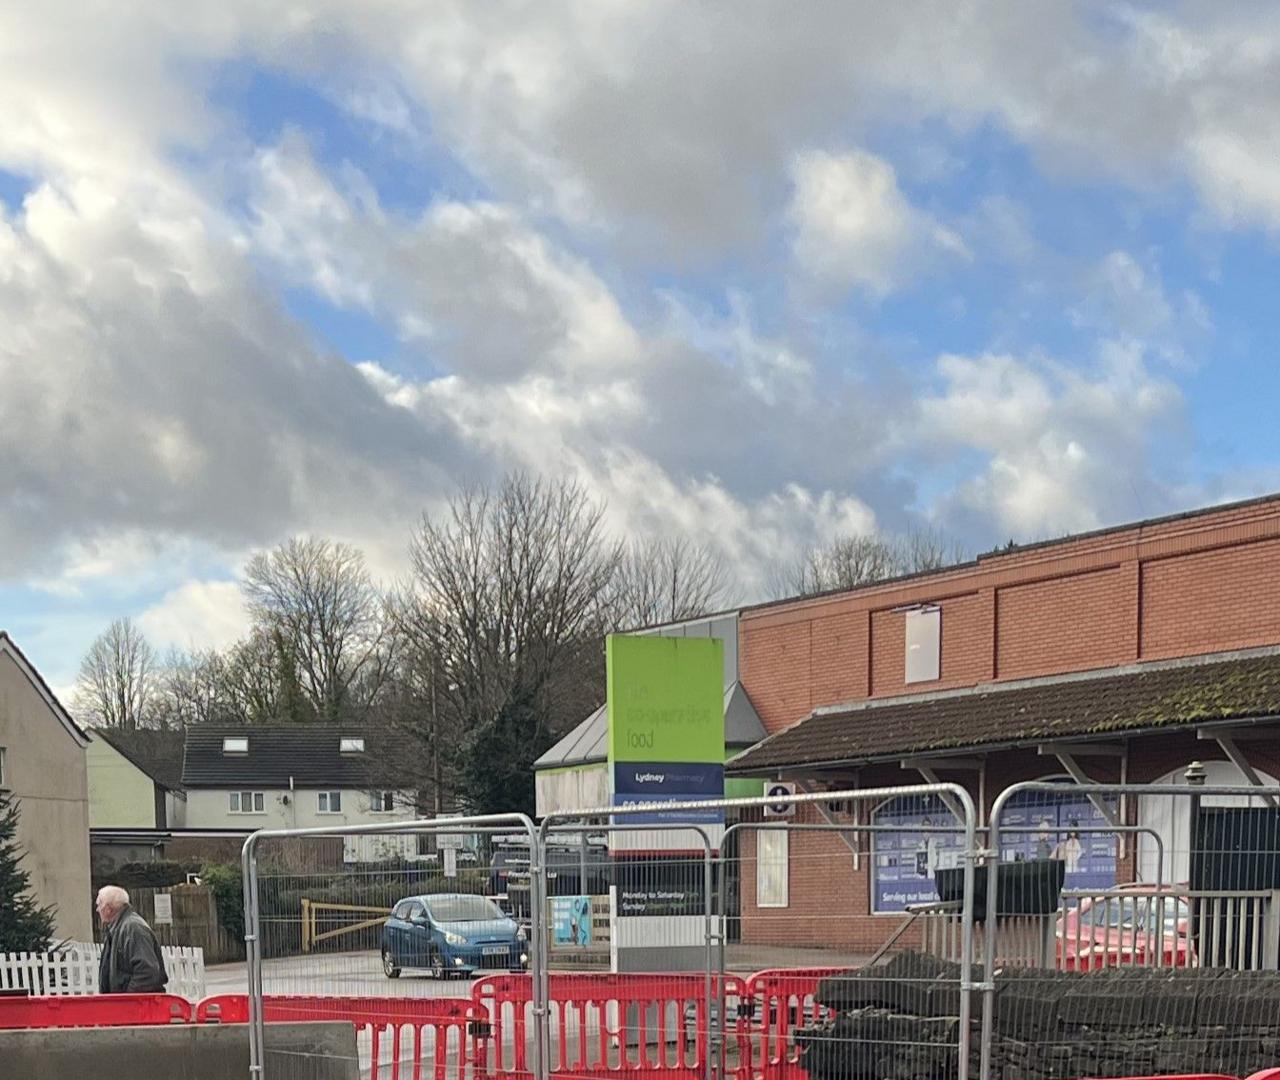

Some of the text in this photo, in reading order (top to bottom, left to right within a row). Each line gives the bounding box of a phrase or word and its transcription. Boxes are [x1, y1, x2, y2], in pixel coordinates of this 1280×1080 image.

[626, 729, 655, 749] food
[635, 772, 665, 783] Lydney
[622, 892, 648, 900] Monday
[657, 891, 685, 900] Saturday
[882, 891, 906, 904] Serving
[622, 902, 646, 911] Sunday
